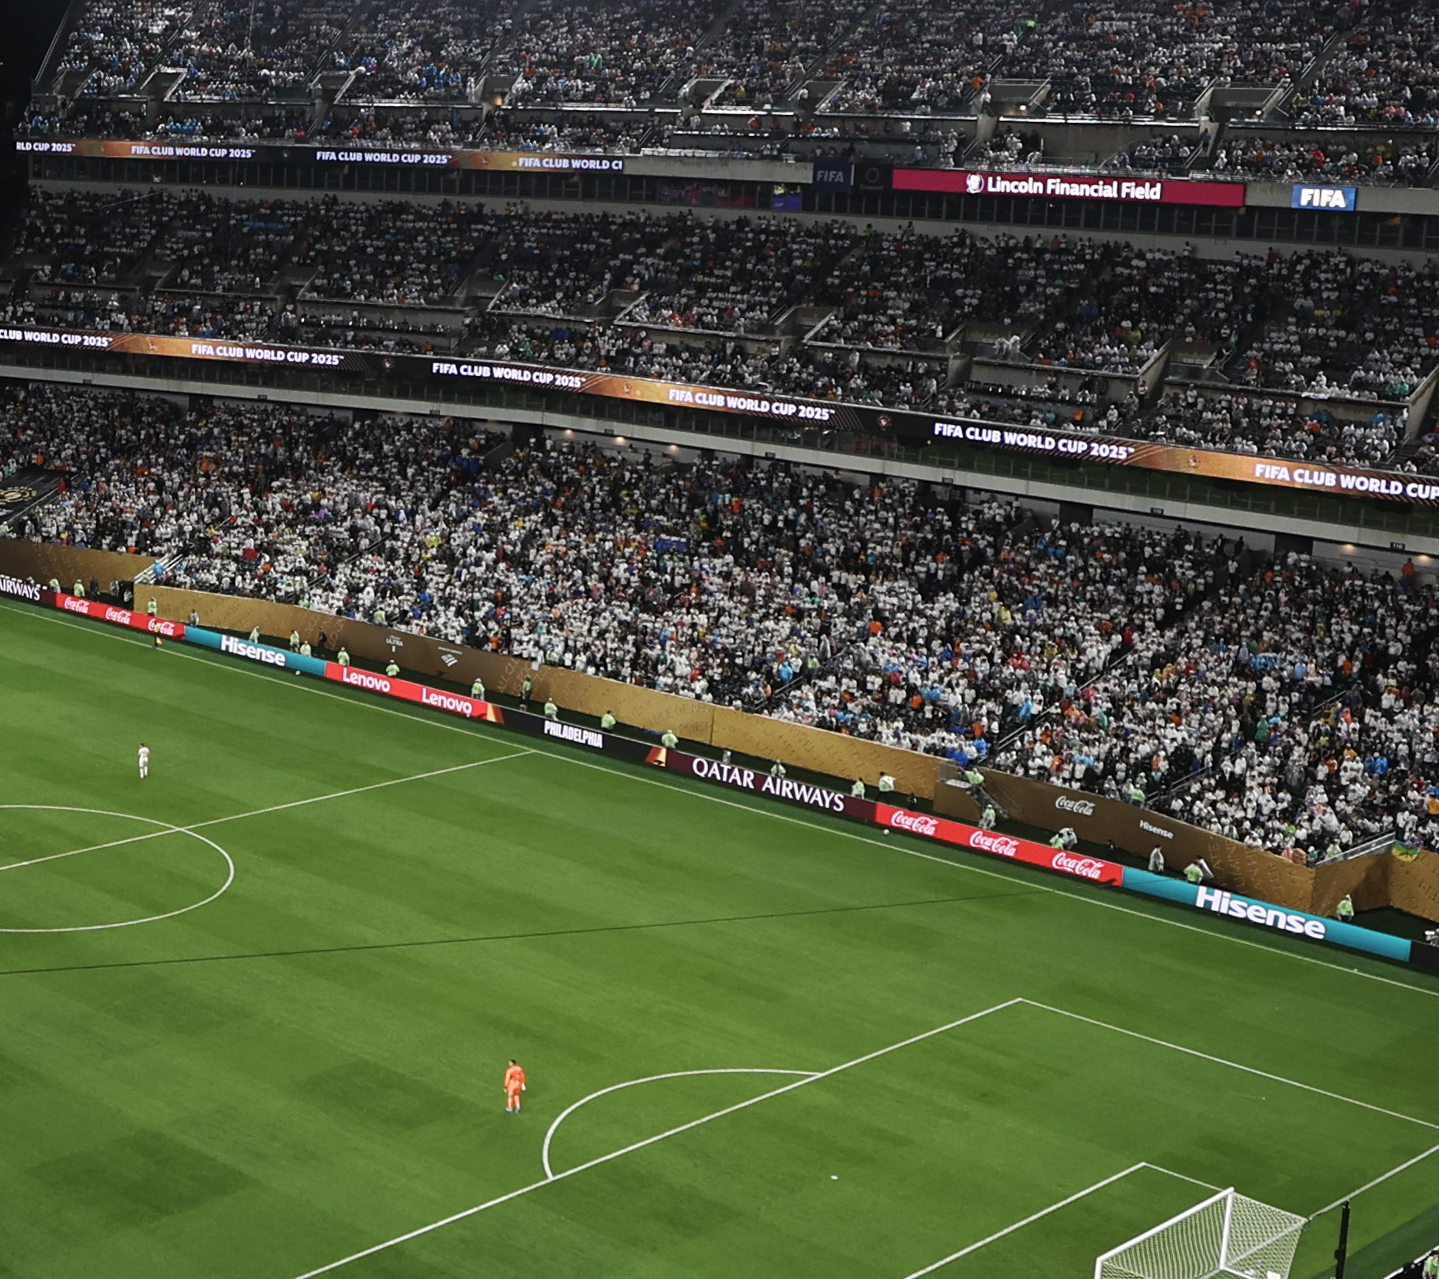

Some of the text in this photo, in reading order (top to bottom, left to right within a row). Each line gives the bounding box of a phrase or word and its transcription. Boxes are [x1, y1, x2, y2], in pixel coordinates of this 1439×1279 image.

[818, 170, 844, 183] FIFA
[987, 175, 1162, 200] Lincoln Financial Field
[1300, 188, 1347, 208] FIFA
[668, 388, 694, 403] FIFA
[694, 392, 725, 407] CLUB
[726, 396, 770, 412] WORLD
[771, 402, 797, 416] CUP
[934, 422, 964, 439] FIFA
[965, 426, 1002, 443] CLUB
[1003, 431, 1056, 450] WORLD
[1057, 438, 1088, 454] CUP
[1254, 463, 1291, 482] FIFA
[1293, 468, 1337, 487] CLUB
[1340, 474, 1403, 495] WORLD
[64, 596, 90, 614] Coca-Cola
[105, 607, 131, 625] Coca-Cola
[220, 635, 286, 667] Hisense
[342, 667, 473, 715] Lenovo Lenovo
[544, 719, 604, 749] PHILADELPHIA
[692, 757, 844, 812] QATAR AIRWAYS
[1055, 795, 1095, 817] Coca-Cola
[890, 810, 1102, 879] Coca-Cola Coca-Cola Coca-Cola
[1139, 819, 1174, 840] Hisense
[1196, 885, 1327, 939] Hisense
